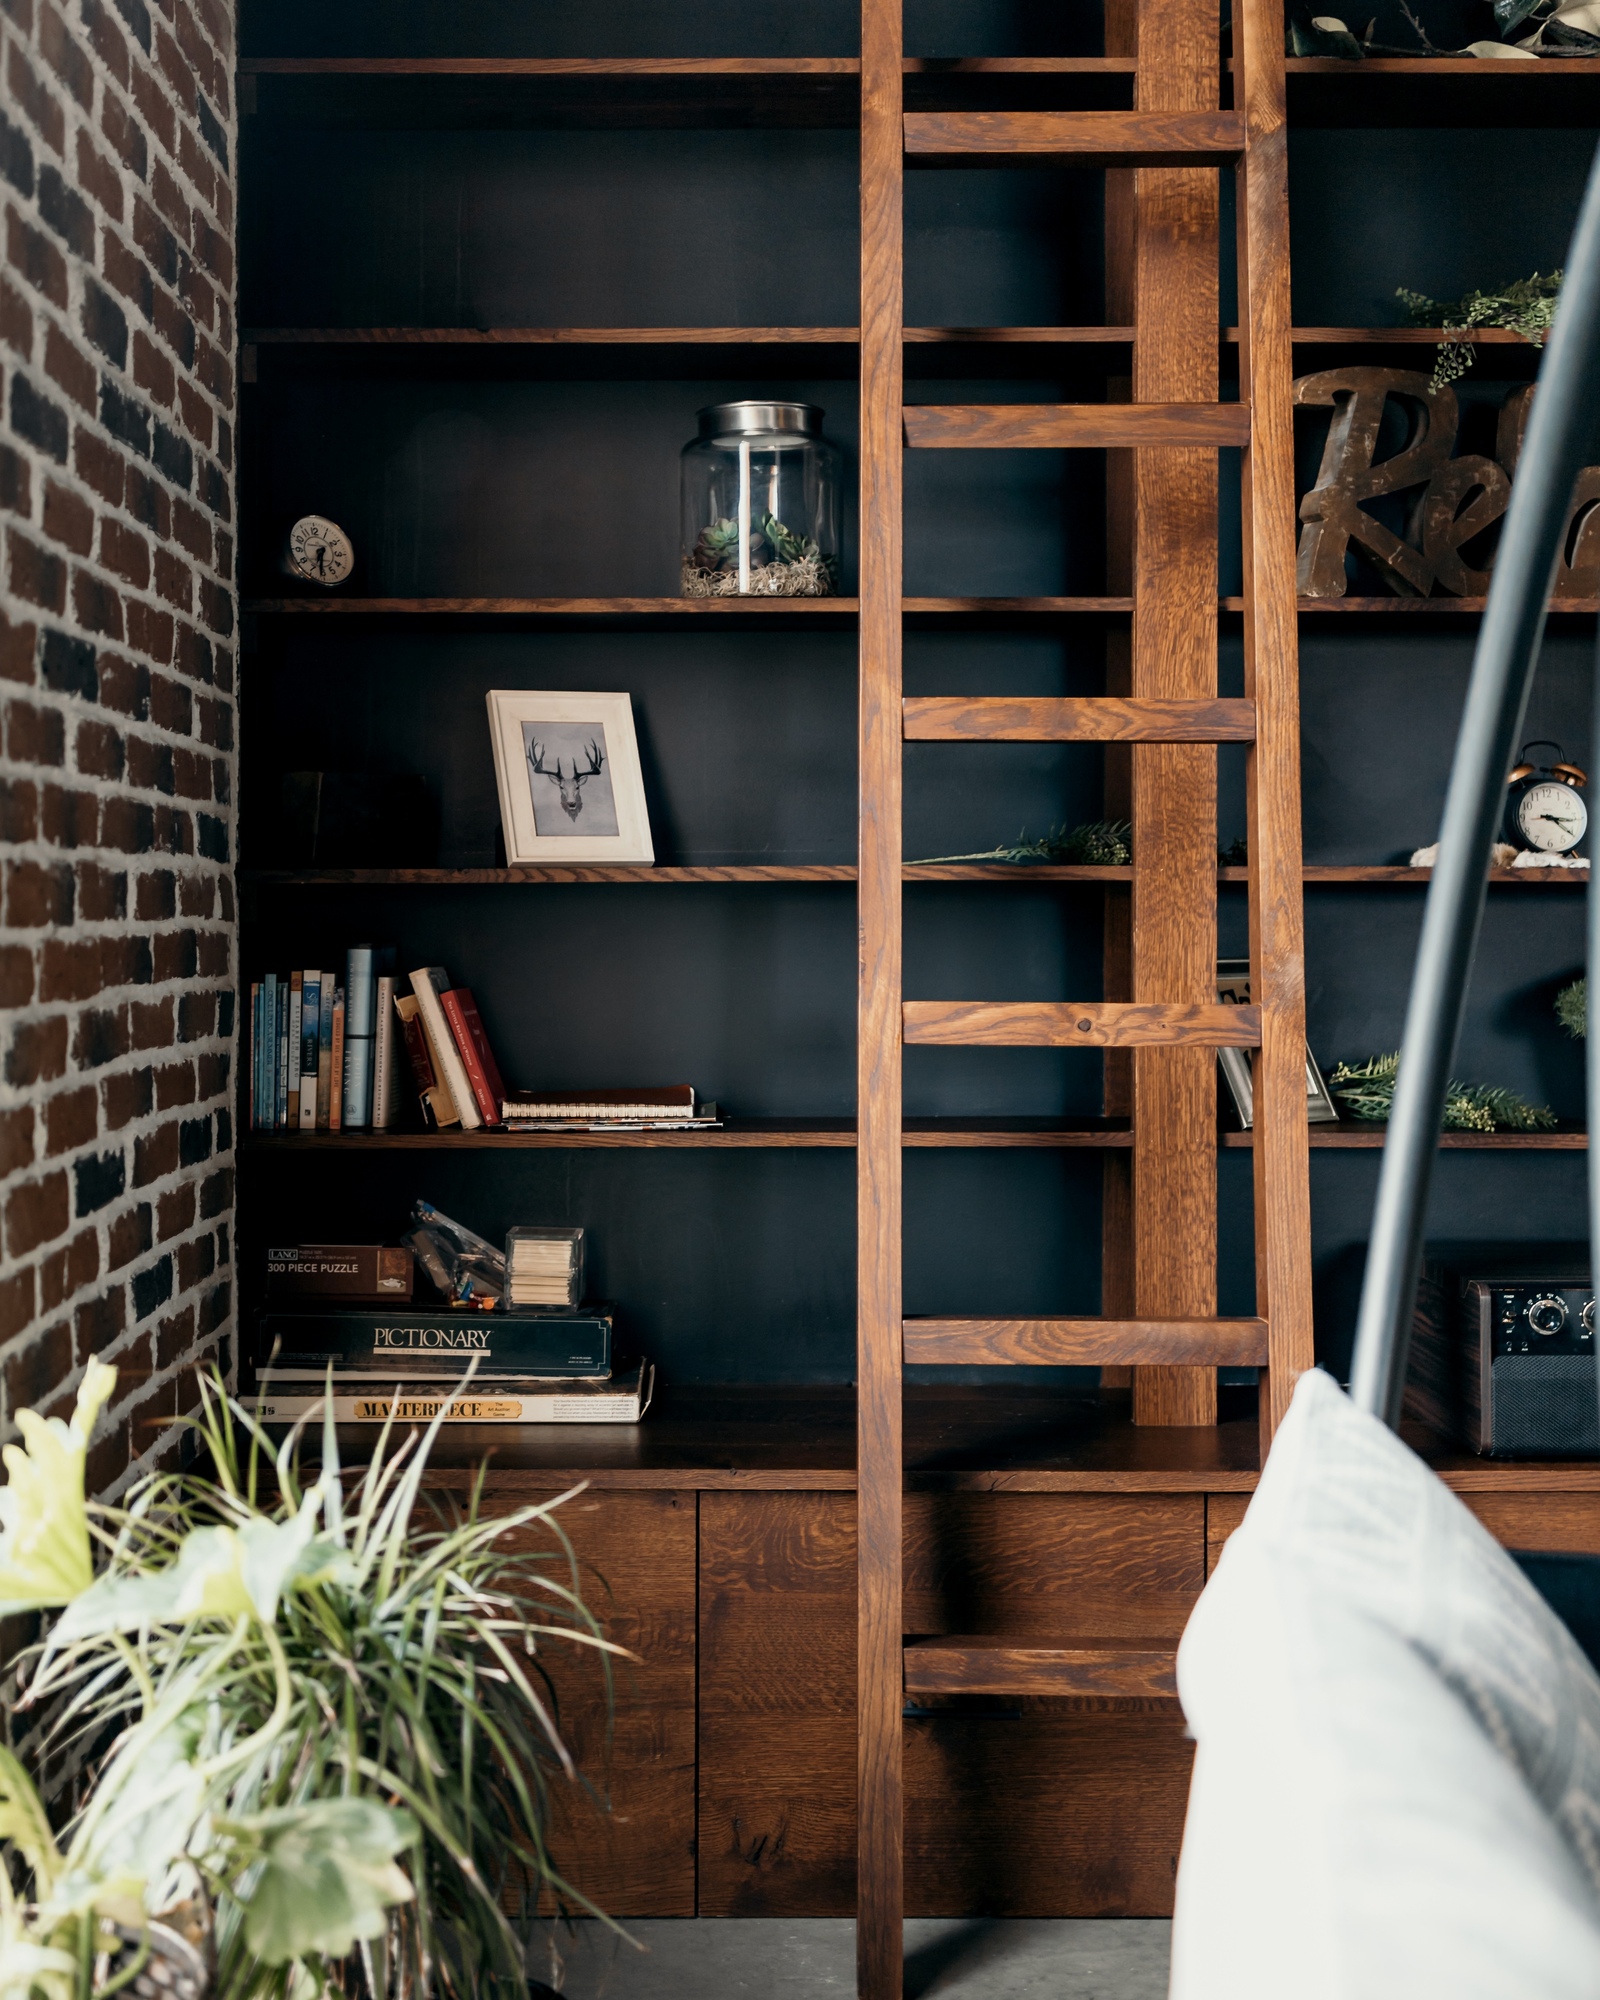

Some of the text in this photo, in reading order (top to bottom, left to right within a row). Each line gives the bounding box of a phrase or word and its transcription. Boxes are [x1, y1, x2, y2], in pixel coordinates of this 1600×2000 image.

[1293, 366, 1600, 598] Re
[302, 528, 310, 538] 11
[310, 526, 319, 536] 12
[295, 535, 304, 545] 10
[329, 540, 338, 548] 2
[334, 550, 342, 558] 3
[300, 556, 308, 564] 8
[334, 560, 342, 568] 4
[310, 564, 316, 572] 7
[328, 566, 336, 575] 5
[1530, 792, 1539, 802] 11
[1542, 788, 1552, 798] 12
[1522, 801, 1532, 810] 10
[1564, 800, 1571, 810] 2
[1520, 813, 1526, 822] 9
[1524, 827, 1530, 836] 8
[1534, 835, 1540, 845] 7
[1547, 839, 1554, 848] 6
[1560, 835, 1566, 844] 5
[324, 991, 332, 1030] Caregiver
[344, 1050, 352, 1094] IRVING
[354, 1056, 362, 1088] JOHN
[271, 1251, 296, 1259] LANG
[268, 1263, 358, 1272] 300 PIECE PUZZLE
[374, 1328, 491, 1347] PICTIONARY
[363, 1402, 482, 1416] MASTERPECE
